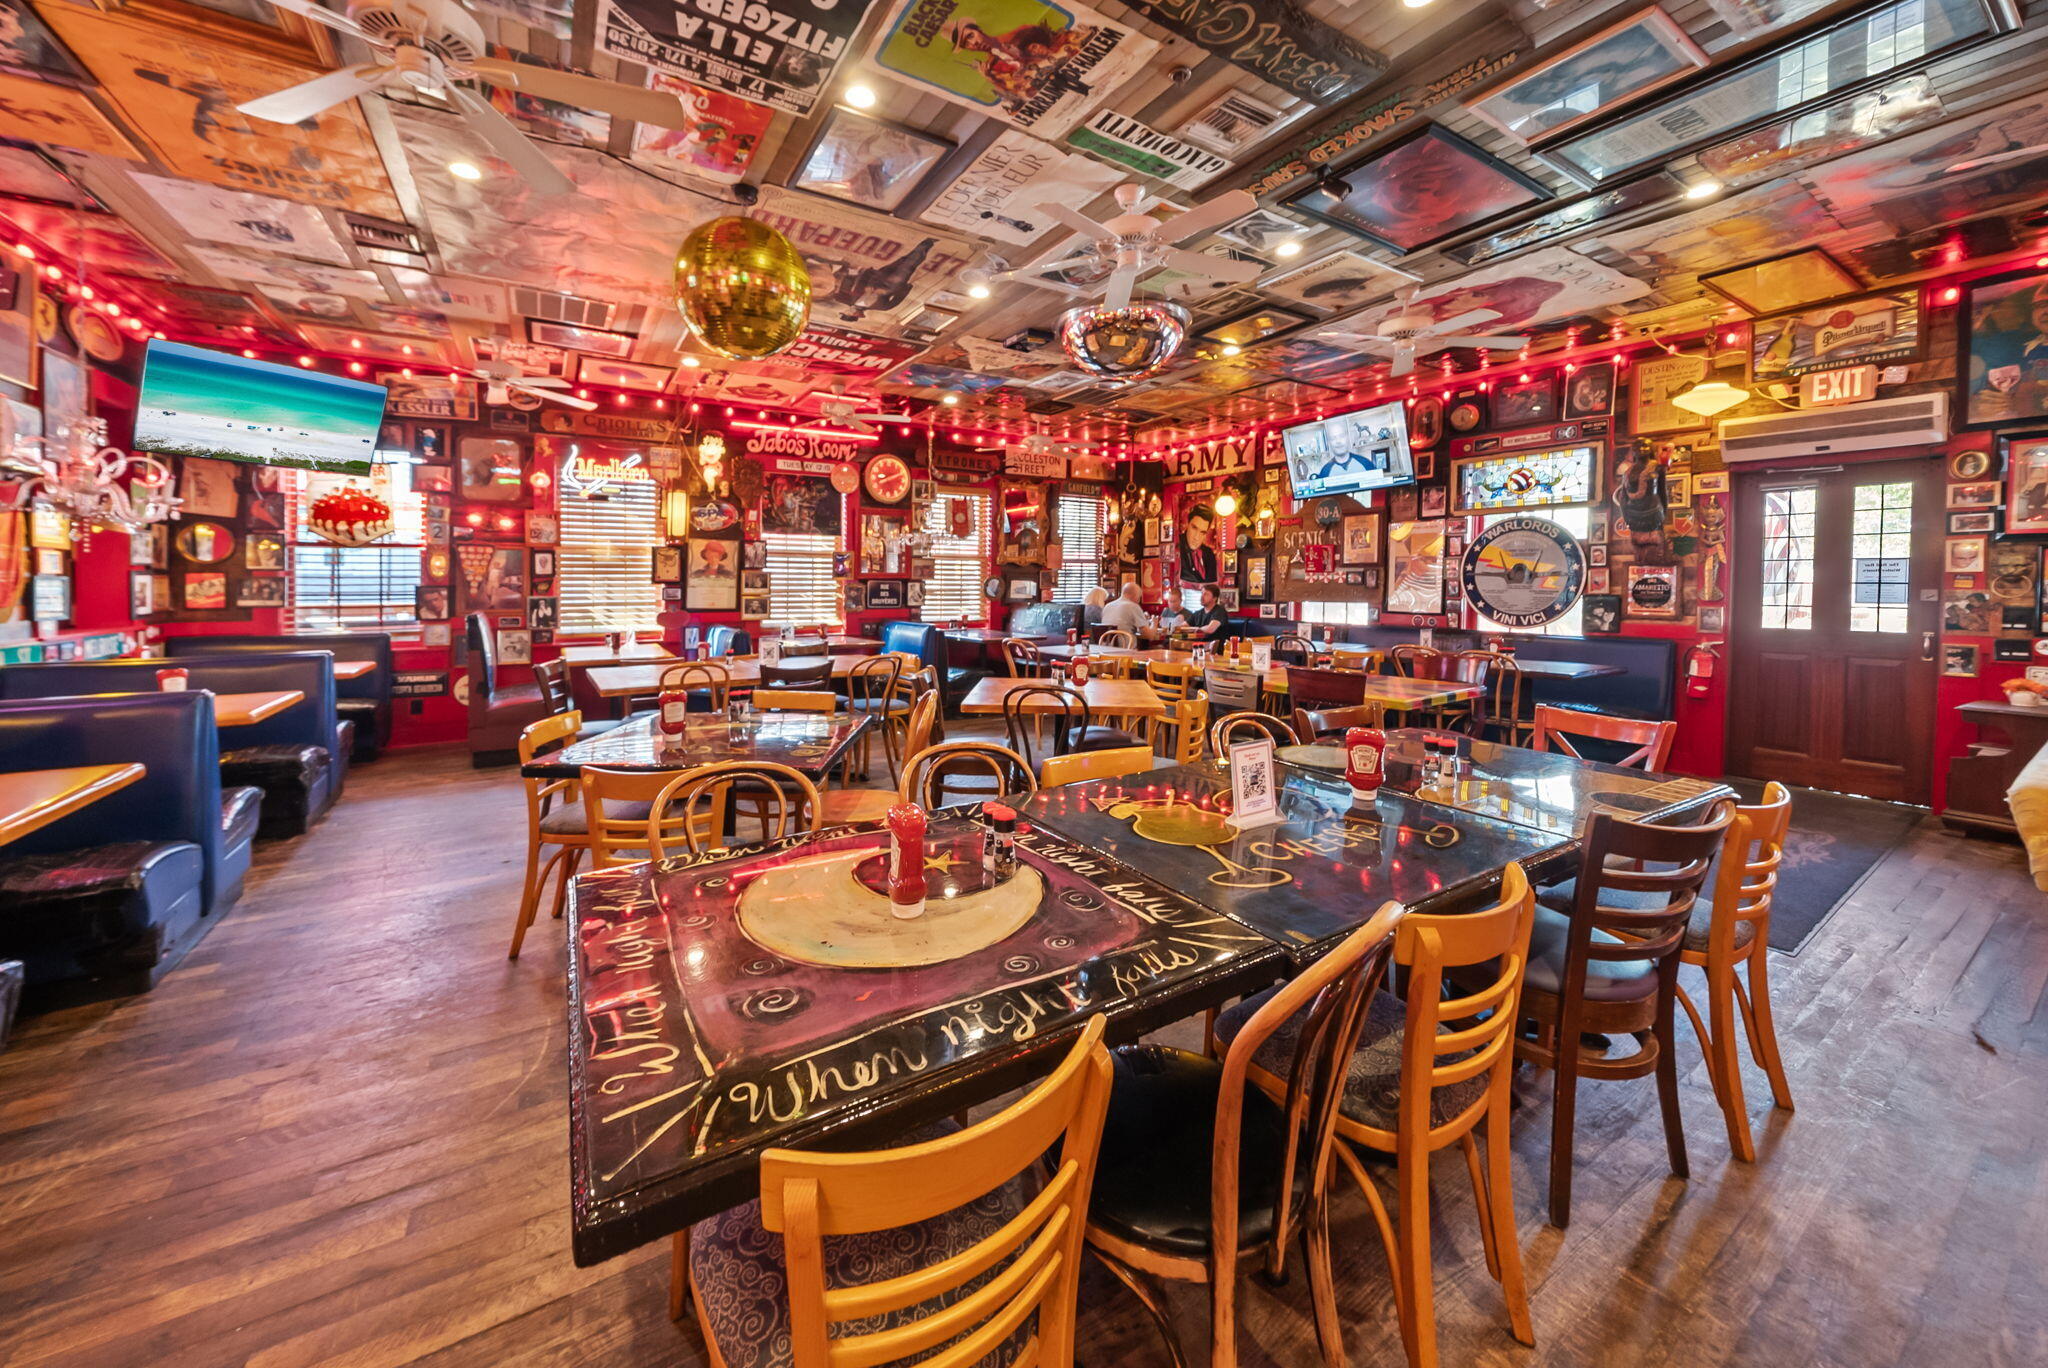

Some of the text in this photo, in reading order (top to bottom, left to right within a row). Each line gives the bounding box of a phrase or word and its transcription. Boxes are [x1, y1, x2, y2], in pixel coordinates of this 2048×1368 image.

[677, 0, 847, 60] FITZGER
[915, 0, 958, 48] CAESAR
[675, 10, 774, 64] ELLA
[609, 43, 649, 63] CIRCUS
[748, 78, 766, 93] 17
[1012, 26, 1126, 128] LE PARRAIN DE HARLEM
[1423, 50, 1519, 110] HILLSHIRE
[1427, 55, 1488, 93] FARM
[735, 85, 765, 102] ROYAL
[1093, 109, 1229, 175] GIACOMETTI
[1309, 100, 1417, 163] SMOKED
[922, 252, 969, 276] LE
[1823, 328, 1854, 348] Pilsner
[1810, 358, 1862, 373] ORIGINAL
[1864, 349, 1912, 364] PILSNER
[1812, 367, 1867, 402] EXIT
[386, 400, 451, 416] KESSLER
[746, 429, 806, 457] Jabo's
[577, 457, 650, 482] Marlboro
[1012, 451, 1062, 466] ECCLESTON
[1012, 463, 1046, 476] STREET
[1317, 507, 1340, 519] 30-A
[433, 526, 443, 540] 2
[1283, 529, 1326, 549] SCENIC
[1484, 519, 1561, 541] WARLORDS
[1492, 610, 1547, 626] VINI VICI
[728, 939, 1200, 1125] When night falls
